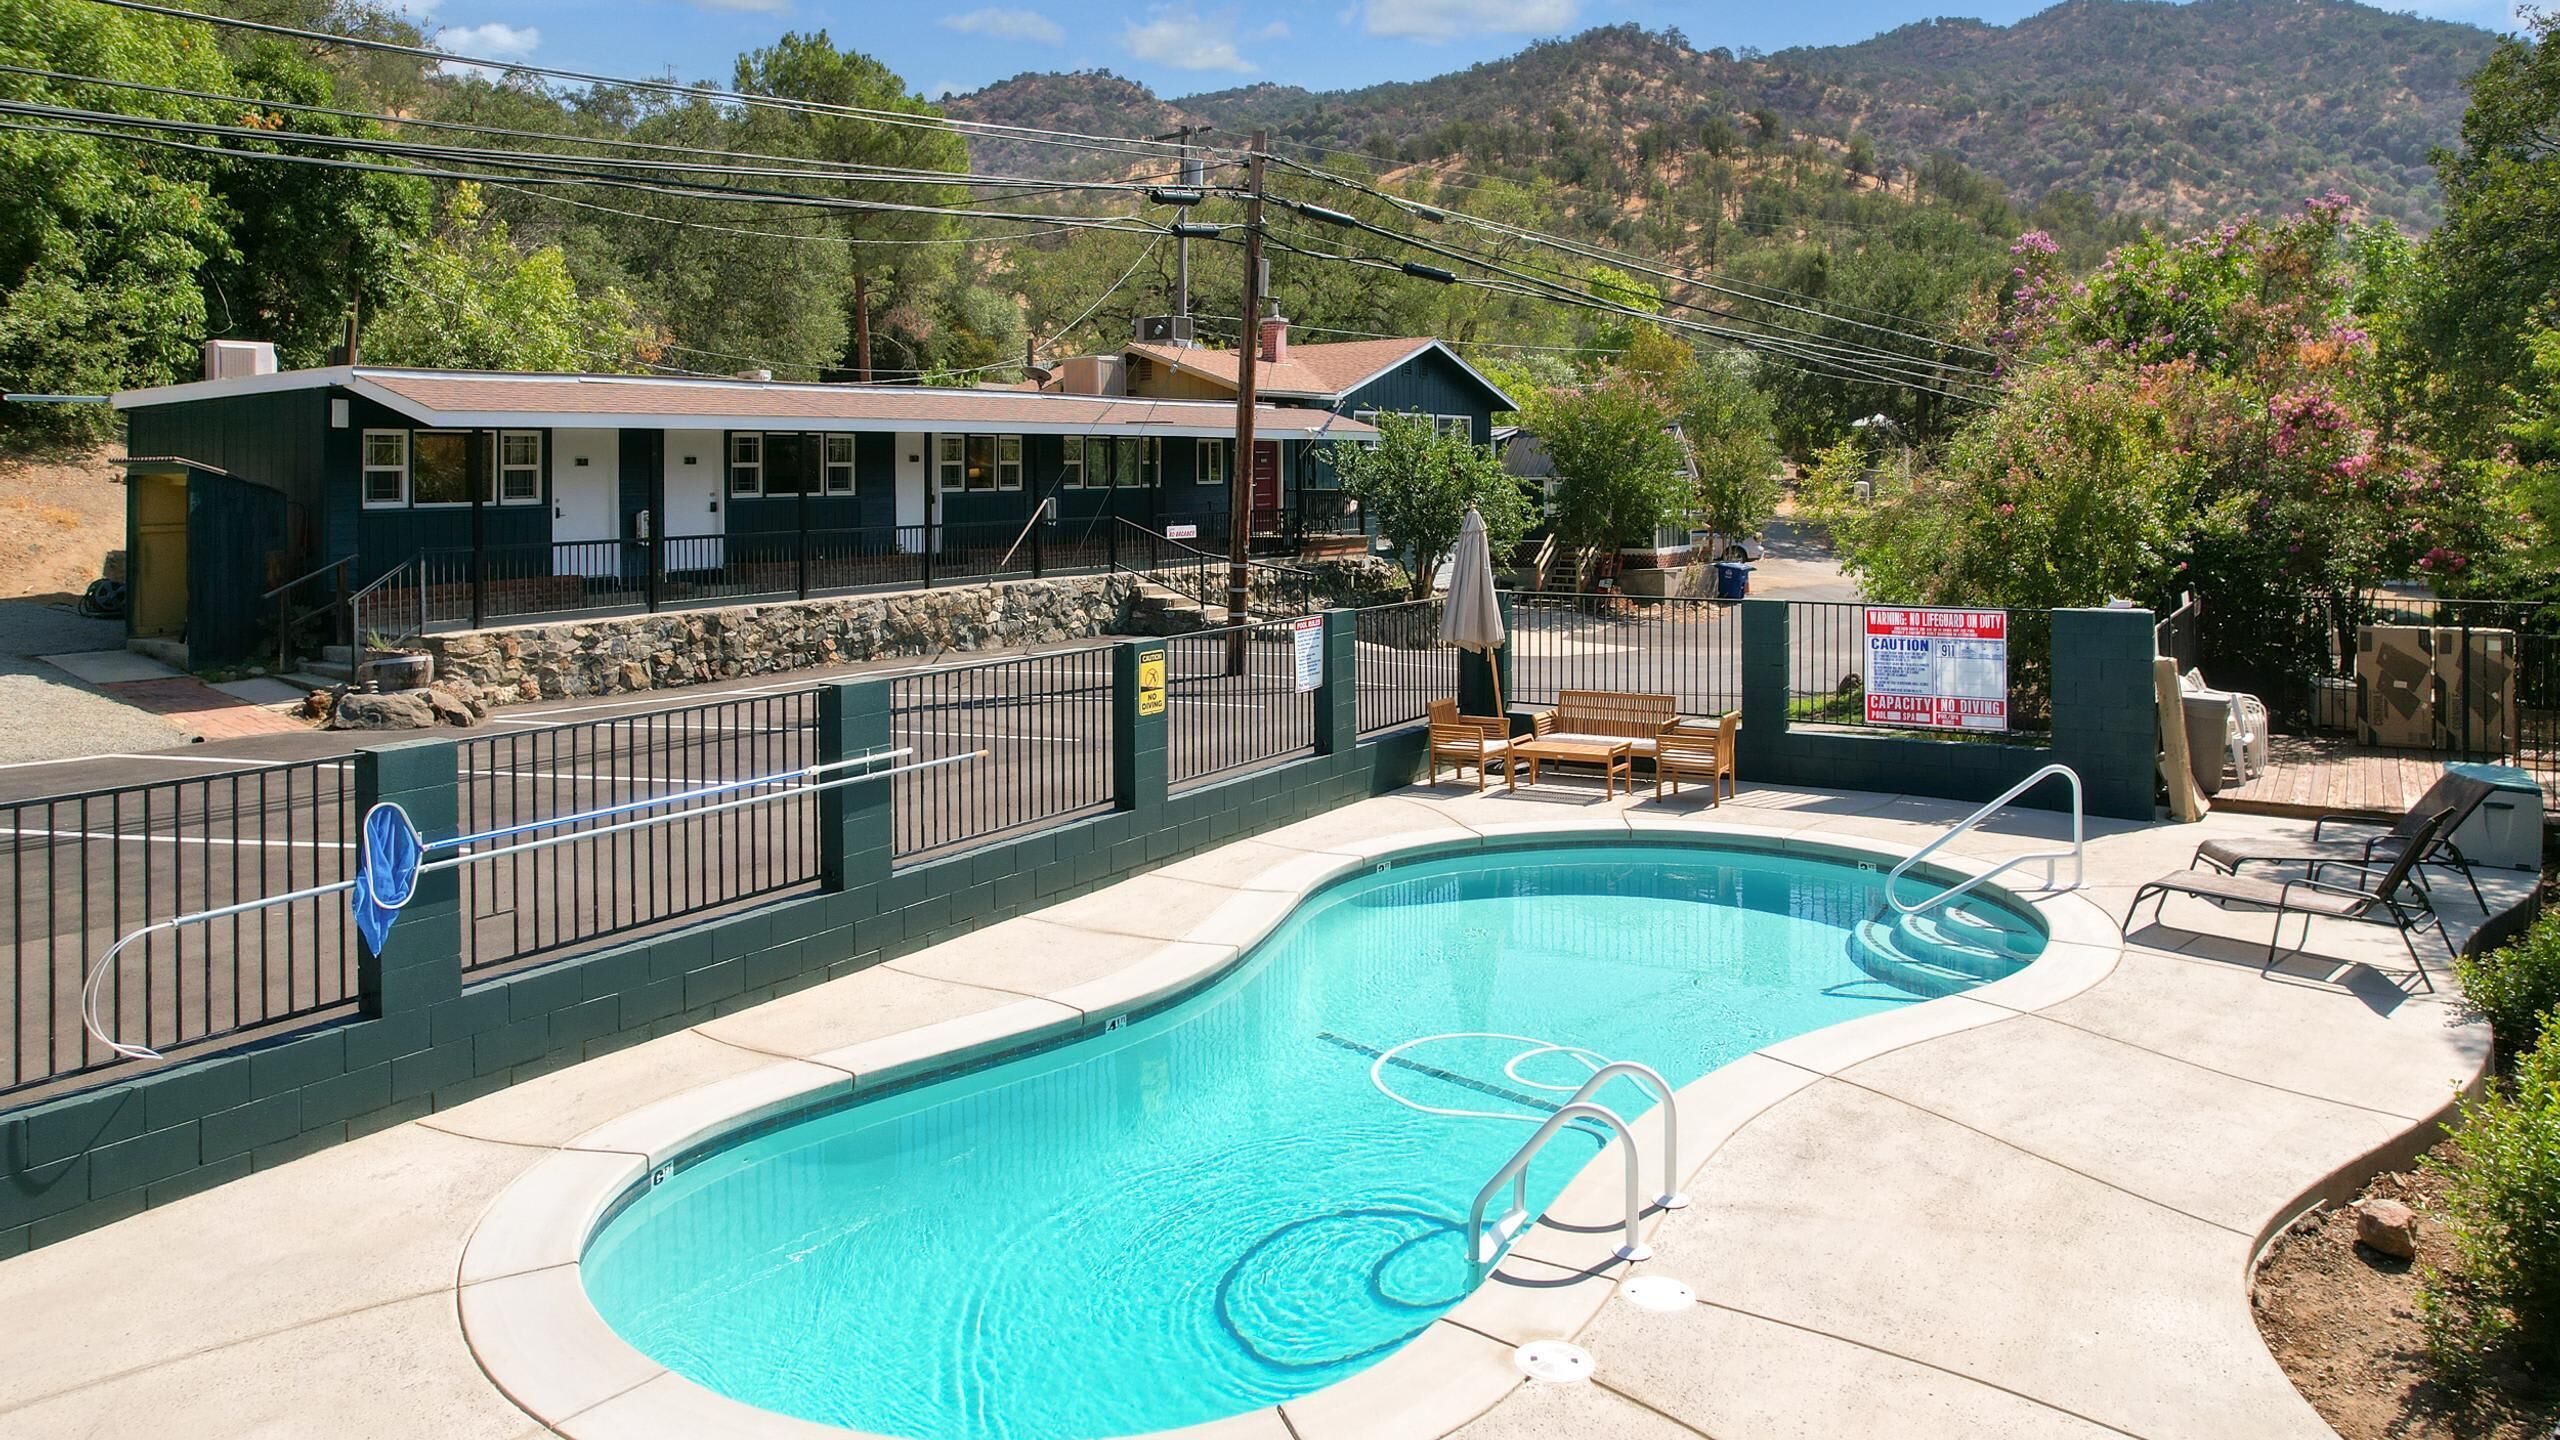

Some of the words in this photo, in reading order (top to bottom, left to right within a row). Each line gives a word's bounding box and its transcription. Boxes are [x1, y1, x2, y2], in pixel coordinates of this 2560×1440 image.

[1869, 611, 1907, 626] WARNING:
[1909, 612, 1920, 626] NO
[1922, 613, 1965, 628] LIFEGUARD
[1967, 614, 1978, 628] ON
[1979, 614, 2001, 629] DUTY
[1871, 638, 1929, 651] CAUTION
[1941, 645, 1955, 657] 911
[1142, 653, 1163, 662] CAUTION
[1147, 692, 1157, 701] NO
[1142, 700, 1163, 710] DIVING
[1870, 695, 1931, 711] CAPACITY
[1940, 699, 1955, 712] NO
[1960, 700, 2000, 714] DIVING
[1871, 711, 1888, 719] POOL
[1902, 712, 1915, 721] SPA
